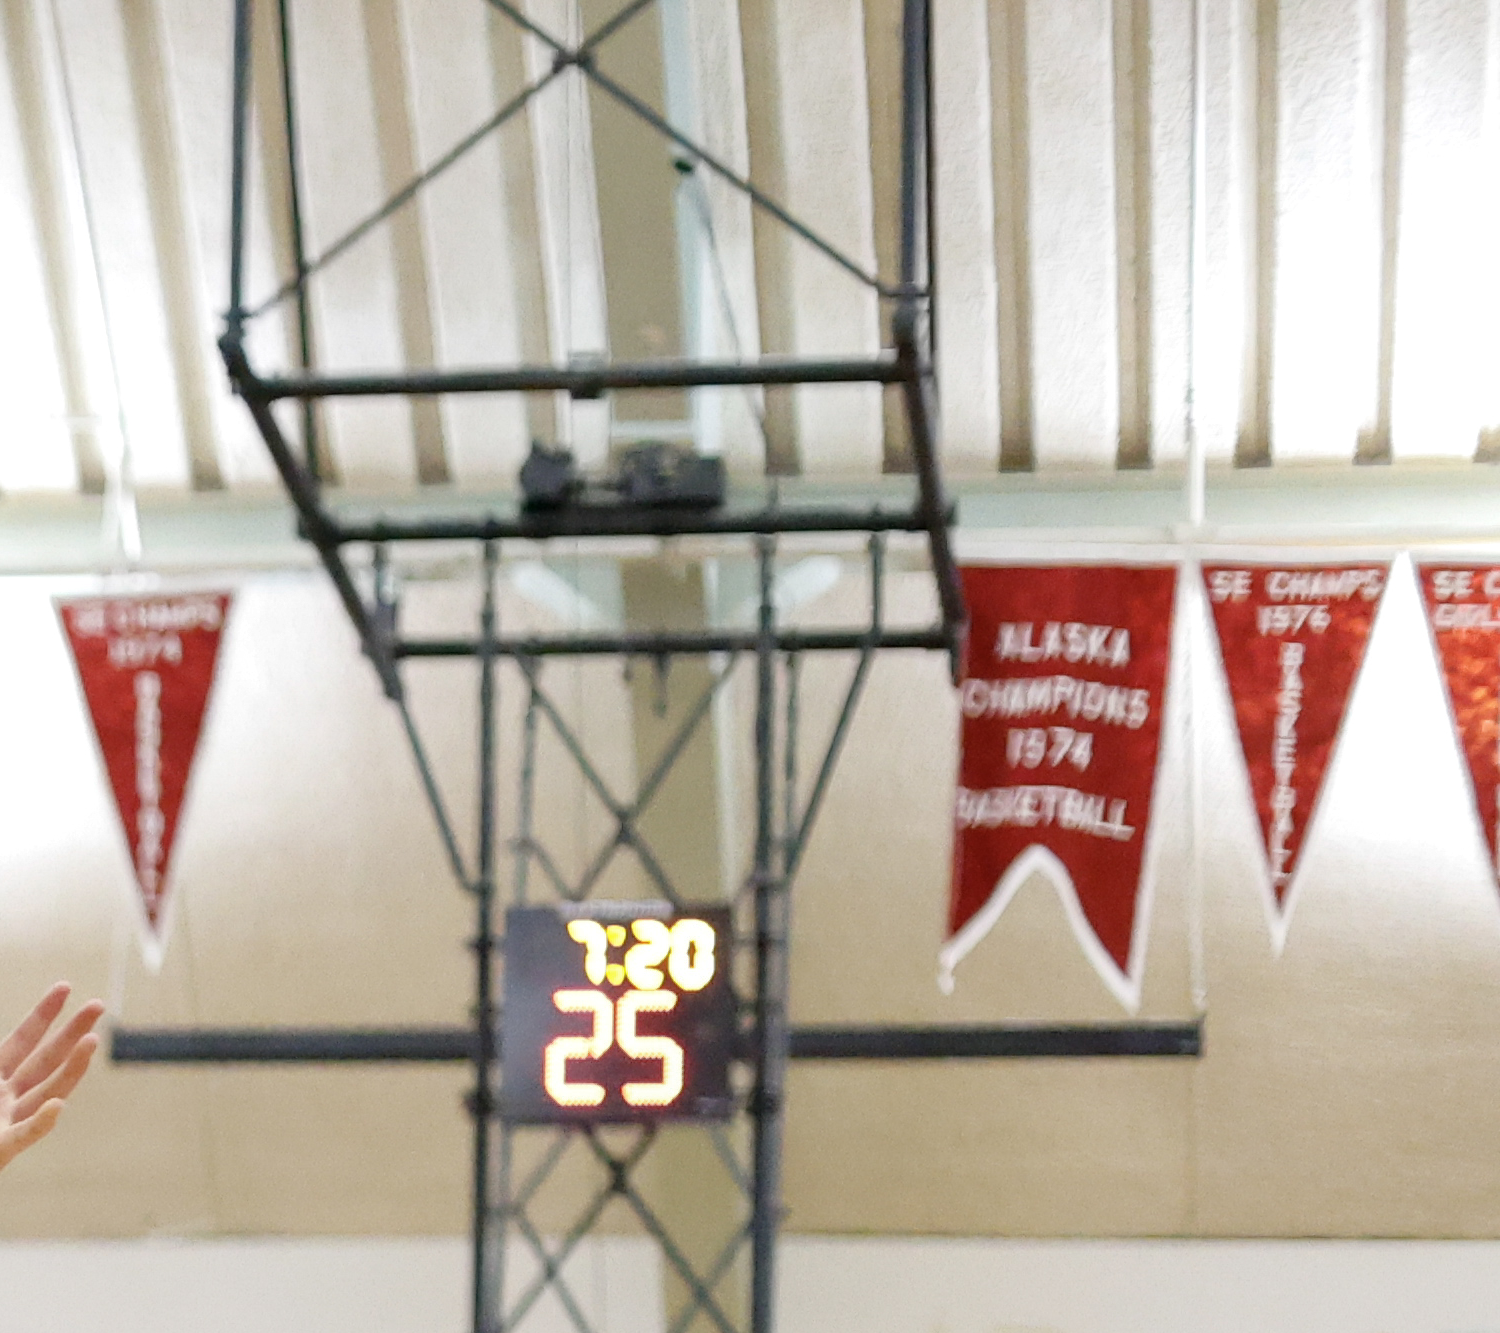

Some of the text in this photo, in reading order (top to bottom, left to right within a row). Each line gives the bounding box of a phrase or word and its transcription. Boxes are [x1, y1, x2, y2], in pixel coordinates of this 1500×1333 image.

[1209, 567, 1388, 602] SE CHAMPS
[1433, 570, 1475, 600] SE
[996, 621, 1131, 667] ALASKA
[961, 674, 1150, 729] CHAMPIONS
[567, 919, 715, 990] 7:20
[545, 989, 683, 1106] 25
